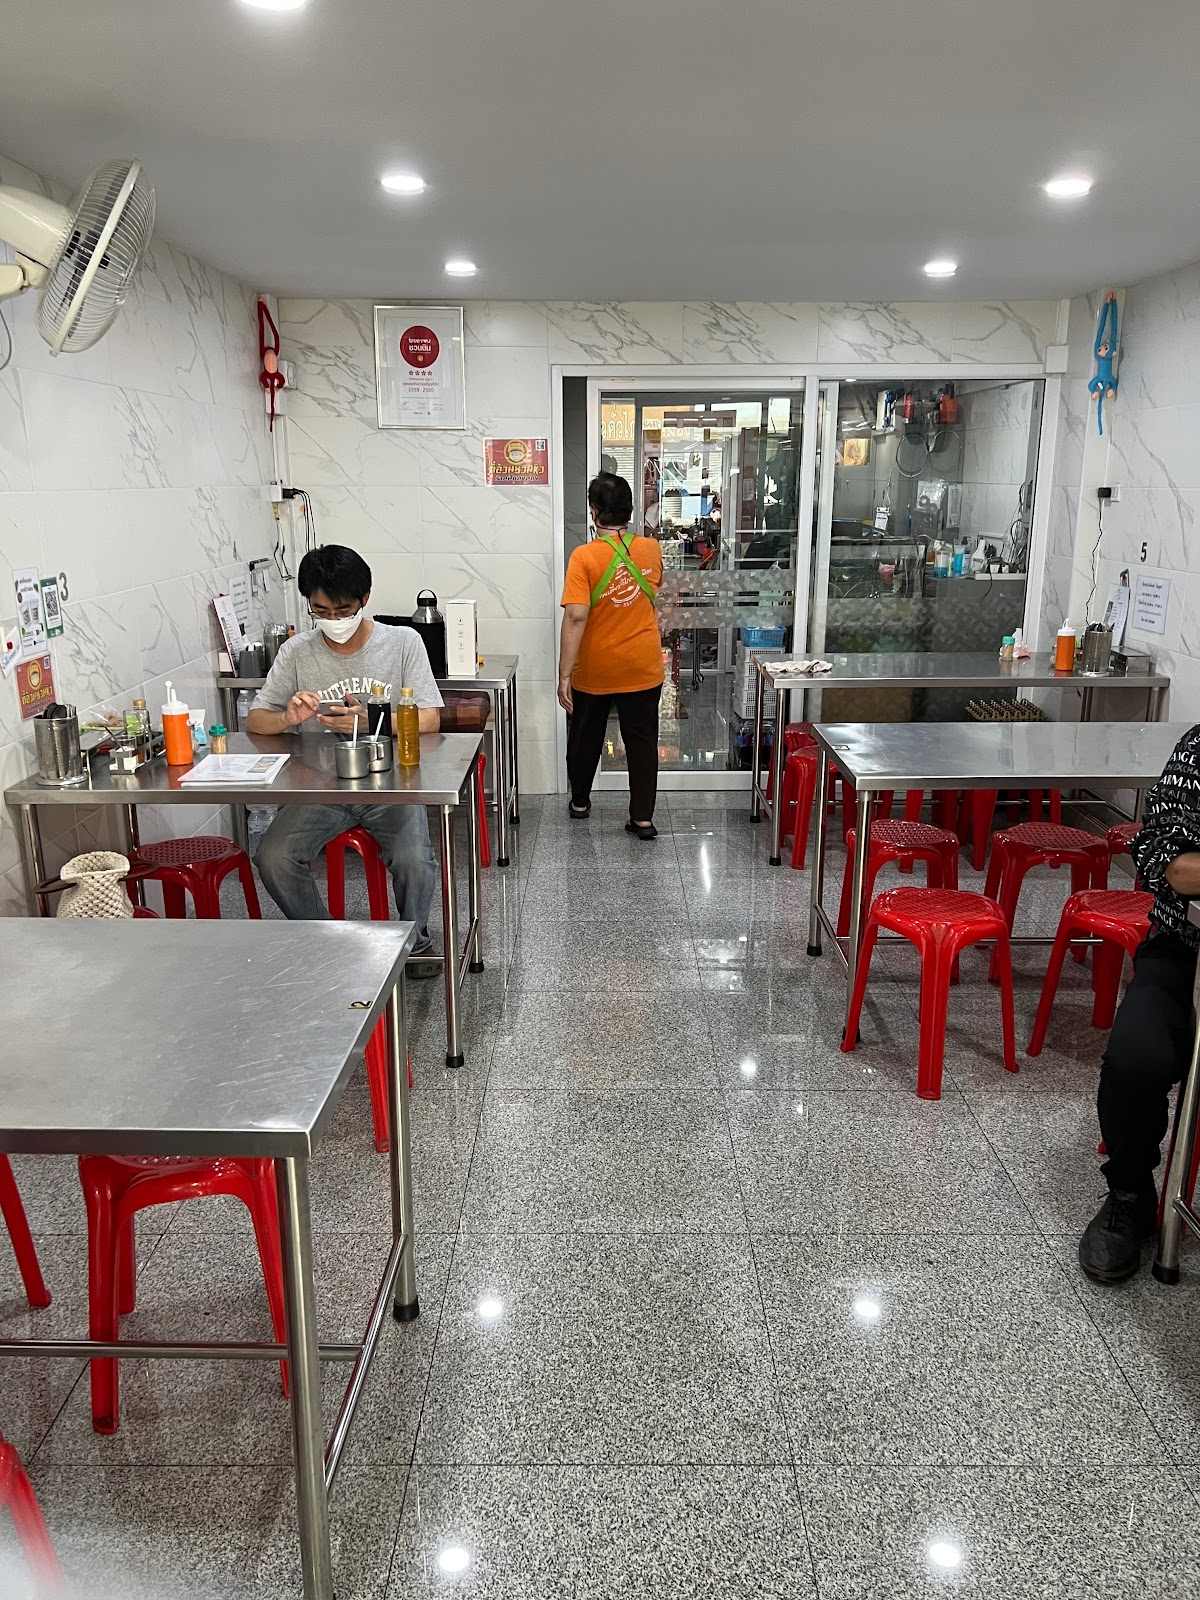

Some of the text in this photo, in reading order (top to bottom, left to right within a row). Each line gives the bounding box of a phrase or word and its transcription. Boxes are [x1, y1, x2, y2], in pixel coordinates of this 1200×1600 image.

[1140, 542, 1147, 562] 5
[59, 572, 68, 601] 3
[317, 677, 393, 701] UTHENTC
